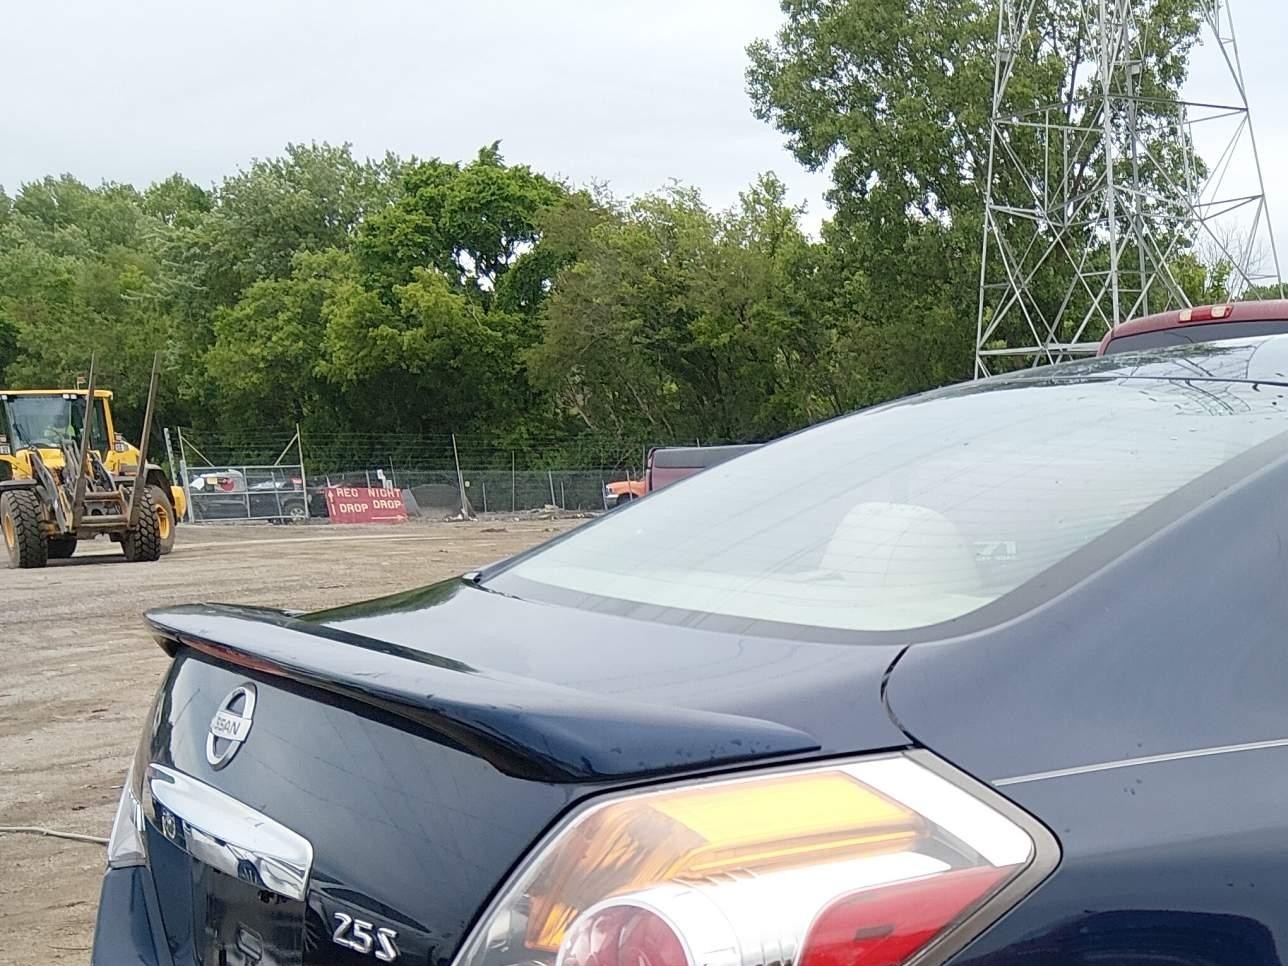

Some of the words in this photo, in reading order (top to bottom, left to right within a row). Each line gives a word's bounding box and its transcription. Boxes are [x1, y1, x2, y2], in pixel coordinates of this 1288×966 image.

[368, 488, 401, 498] NIGHT
[340, 503, 369, 513] DROP
[373, 500, 402, 509] DROP
